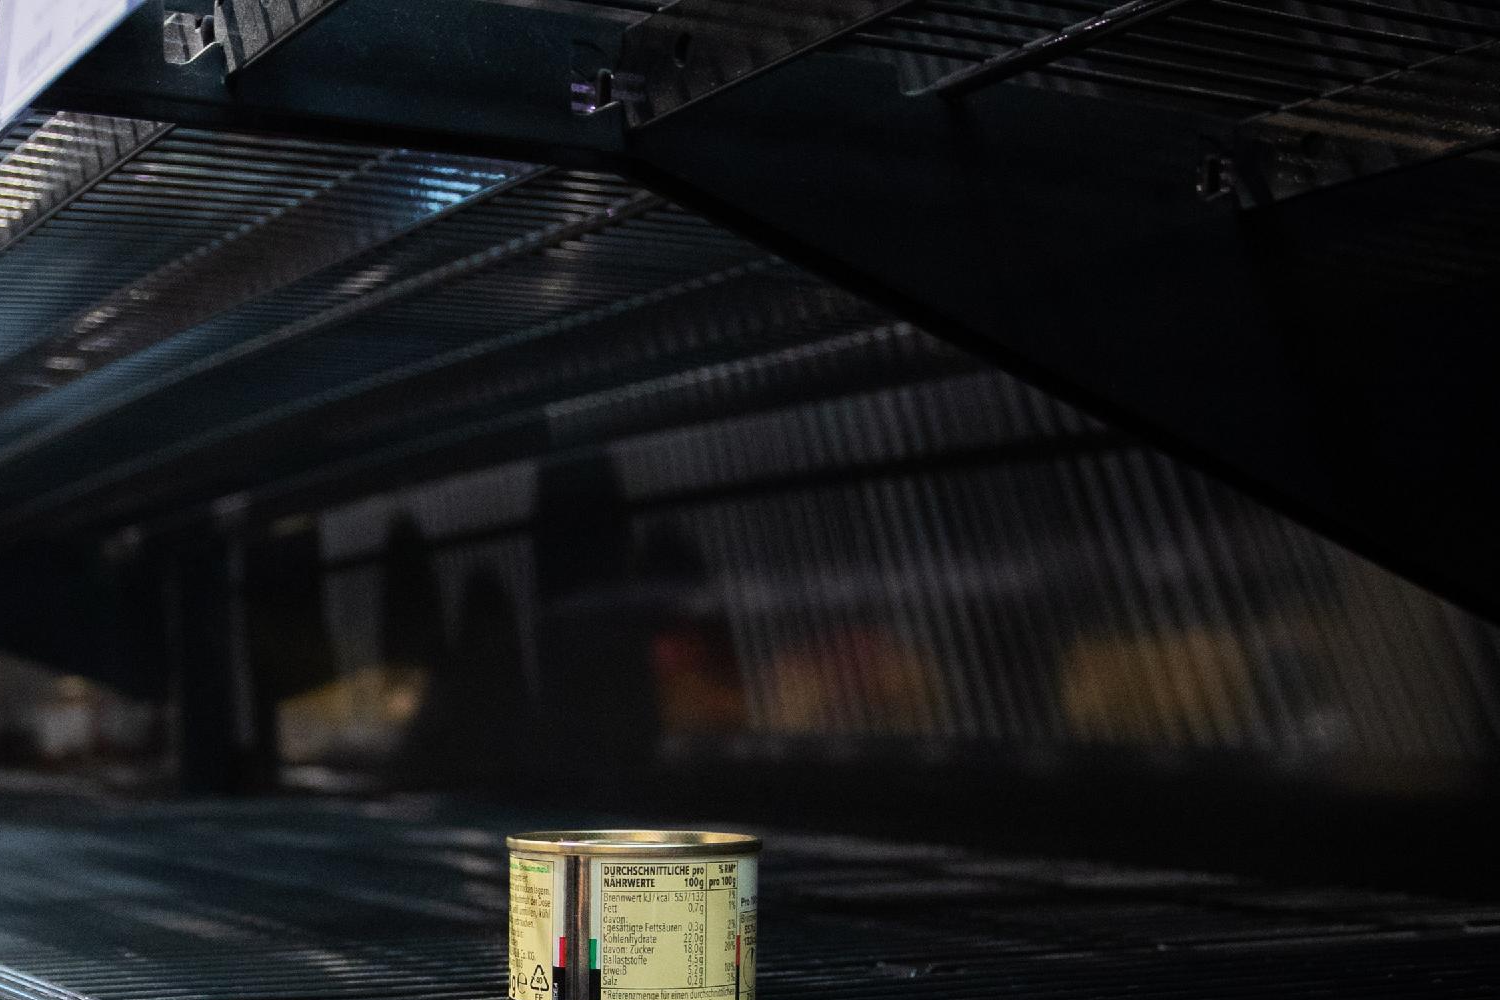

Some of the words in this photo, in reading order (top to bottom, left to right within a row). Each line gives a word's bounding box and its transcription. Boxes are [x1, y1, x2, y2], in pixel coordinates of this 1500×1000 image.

[603, 866, 690, 876] DURCHSCHNITTLICHE
[691, 867, 704, 877] pro
[603, 875, 656, 888] NÄHRWERTE
[708, 878, 719, 889] pro
[603, 892, 642, 902] Brennwert
[603, 902, 617, 913] Fett
[644, 922, 683, 932] Fettsäuren
[603, 933, 657, 945] Kohlenhydrate
[629, 944, 654, 955] Zucker
[603, 954, 648, 965] Ballaststoffe
[602, 964, 628, 976] Eiweiß
[602, 975, 618, 986] Salz
